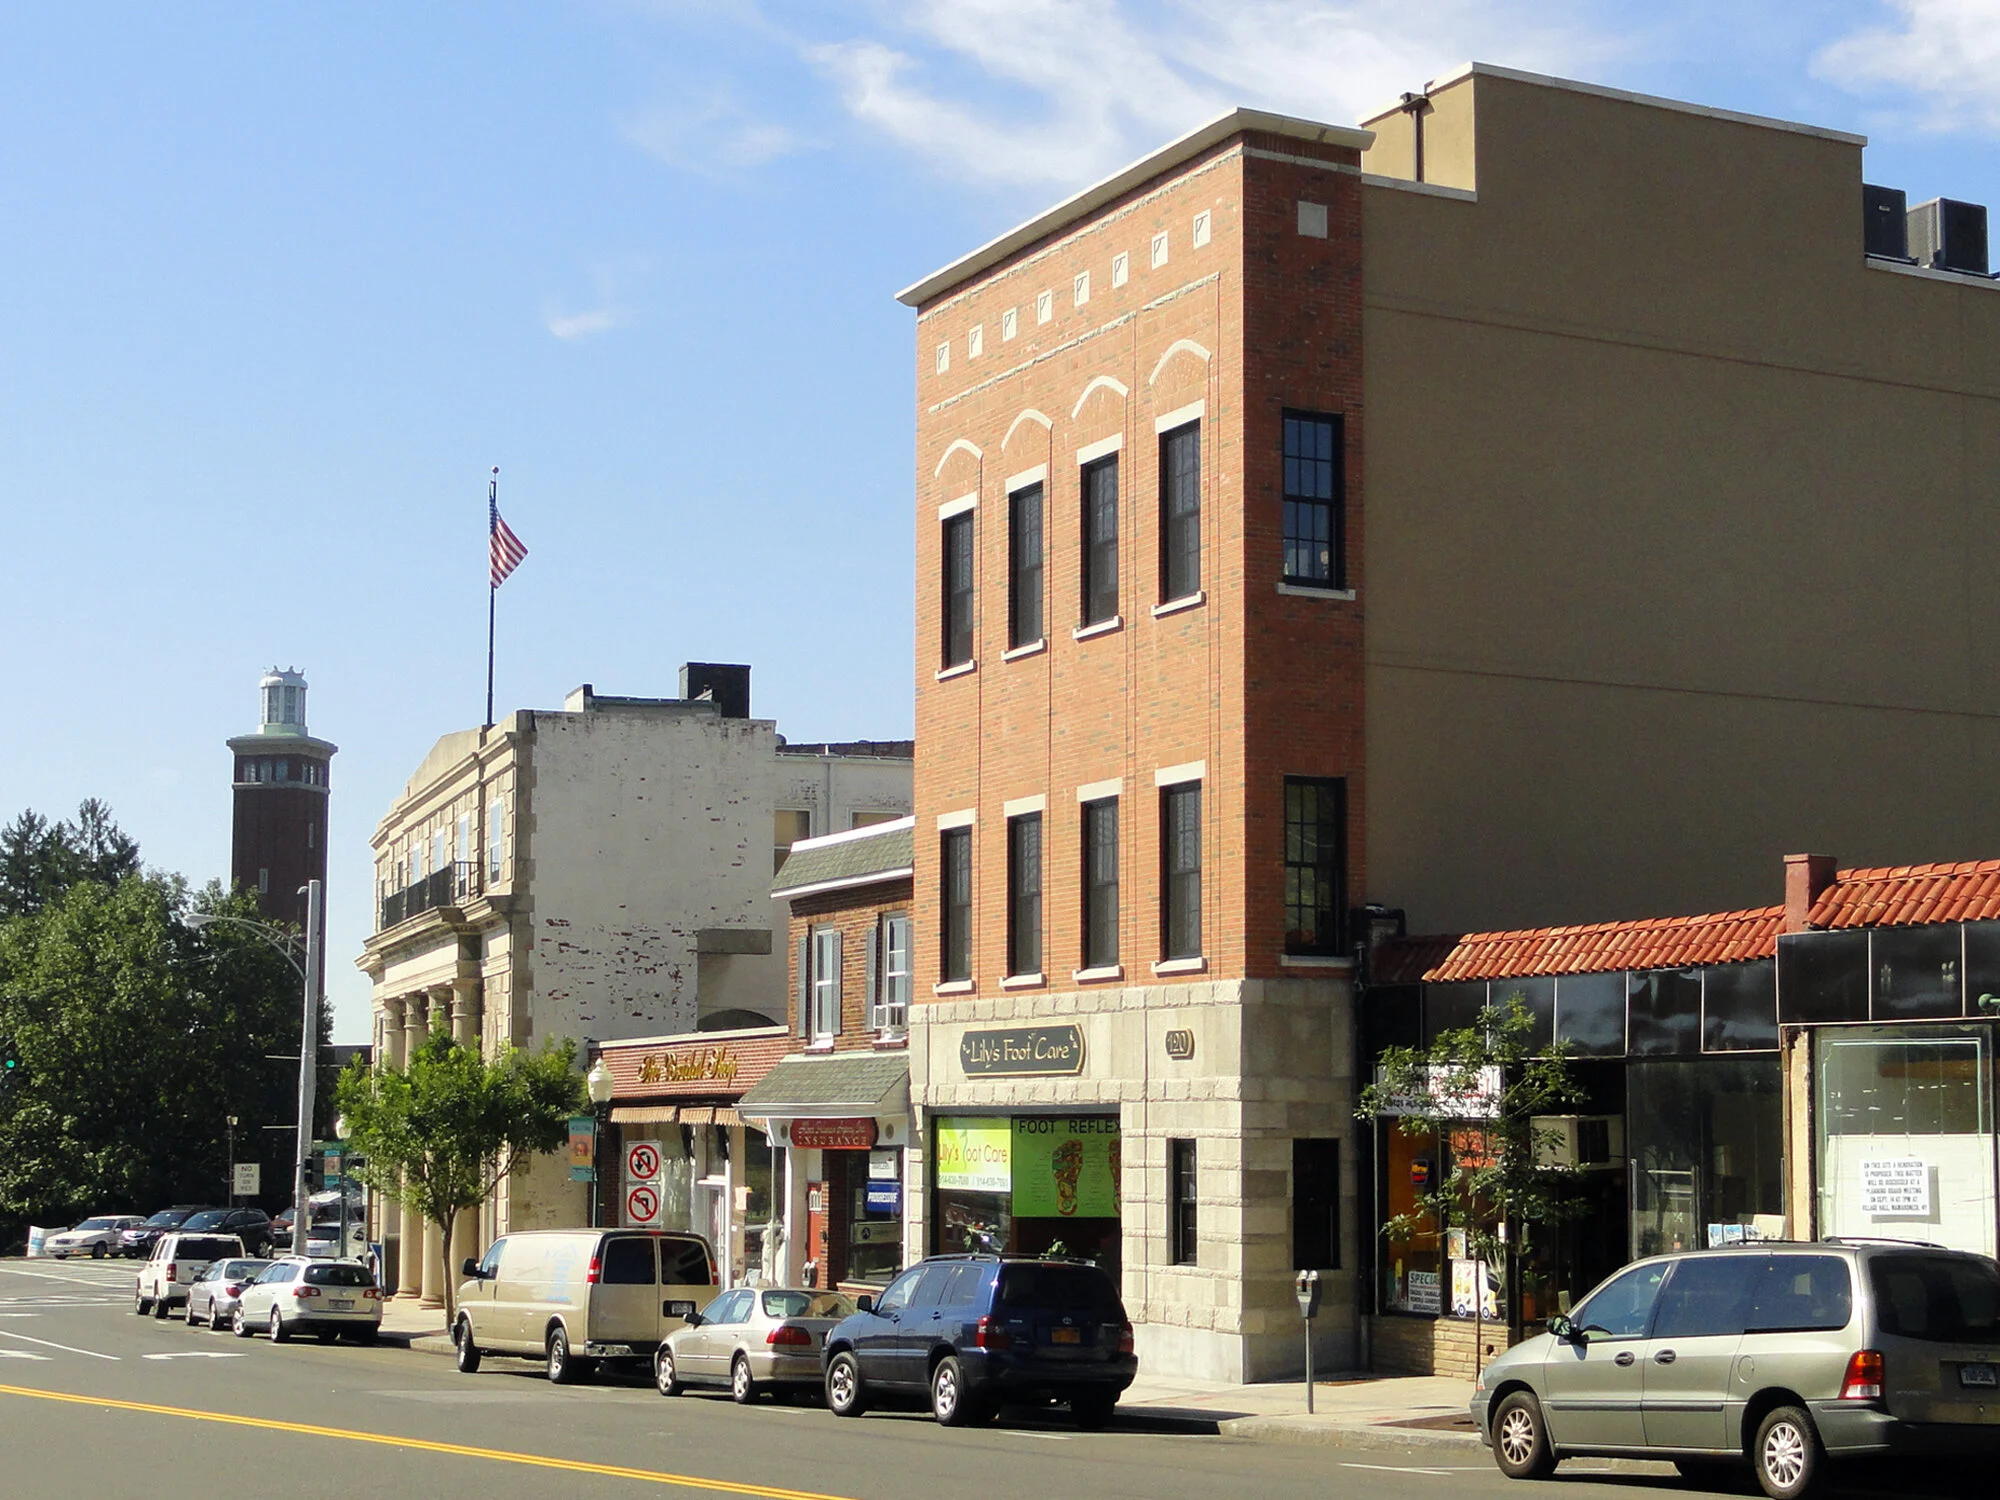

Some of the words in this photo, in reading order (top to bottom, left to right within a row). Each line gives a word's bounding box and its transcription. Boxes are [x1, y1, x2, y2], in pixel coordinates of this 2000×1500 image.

[1167, 1032, 1187, 1052] 120
[970, 1039, 1000, 1068] Lily's
[1003, 1038, 1031, 1061] Foot
[1034, 1037, 1070, 1060] Care
[663, 1048, 706, 1081] Bridal
[705, 1046, 737, 1089] Shop
[1018, 1119, 1056, 1134] FOOT
[1068, 1119, 1121, 1134] REFLEX
[797, 1134, 868, 1147] INSURANCE
[984, 1144, 1009, 1163] Care
[241, 1165, 253, 1173] NO
[1871, 1161, 1880, 1169] THIS
[1881, 1161, 1891, 1169] SITE
